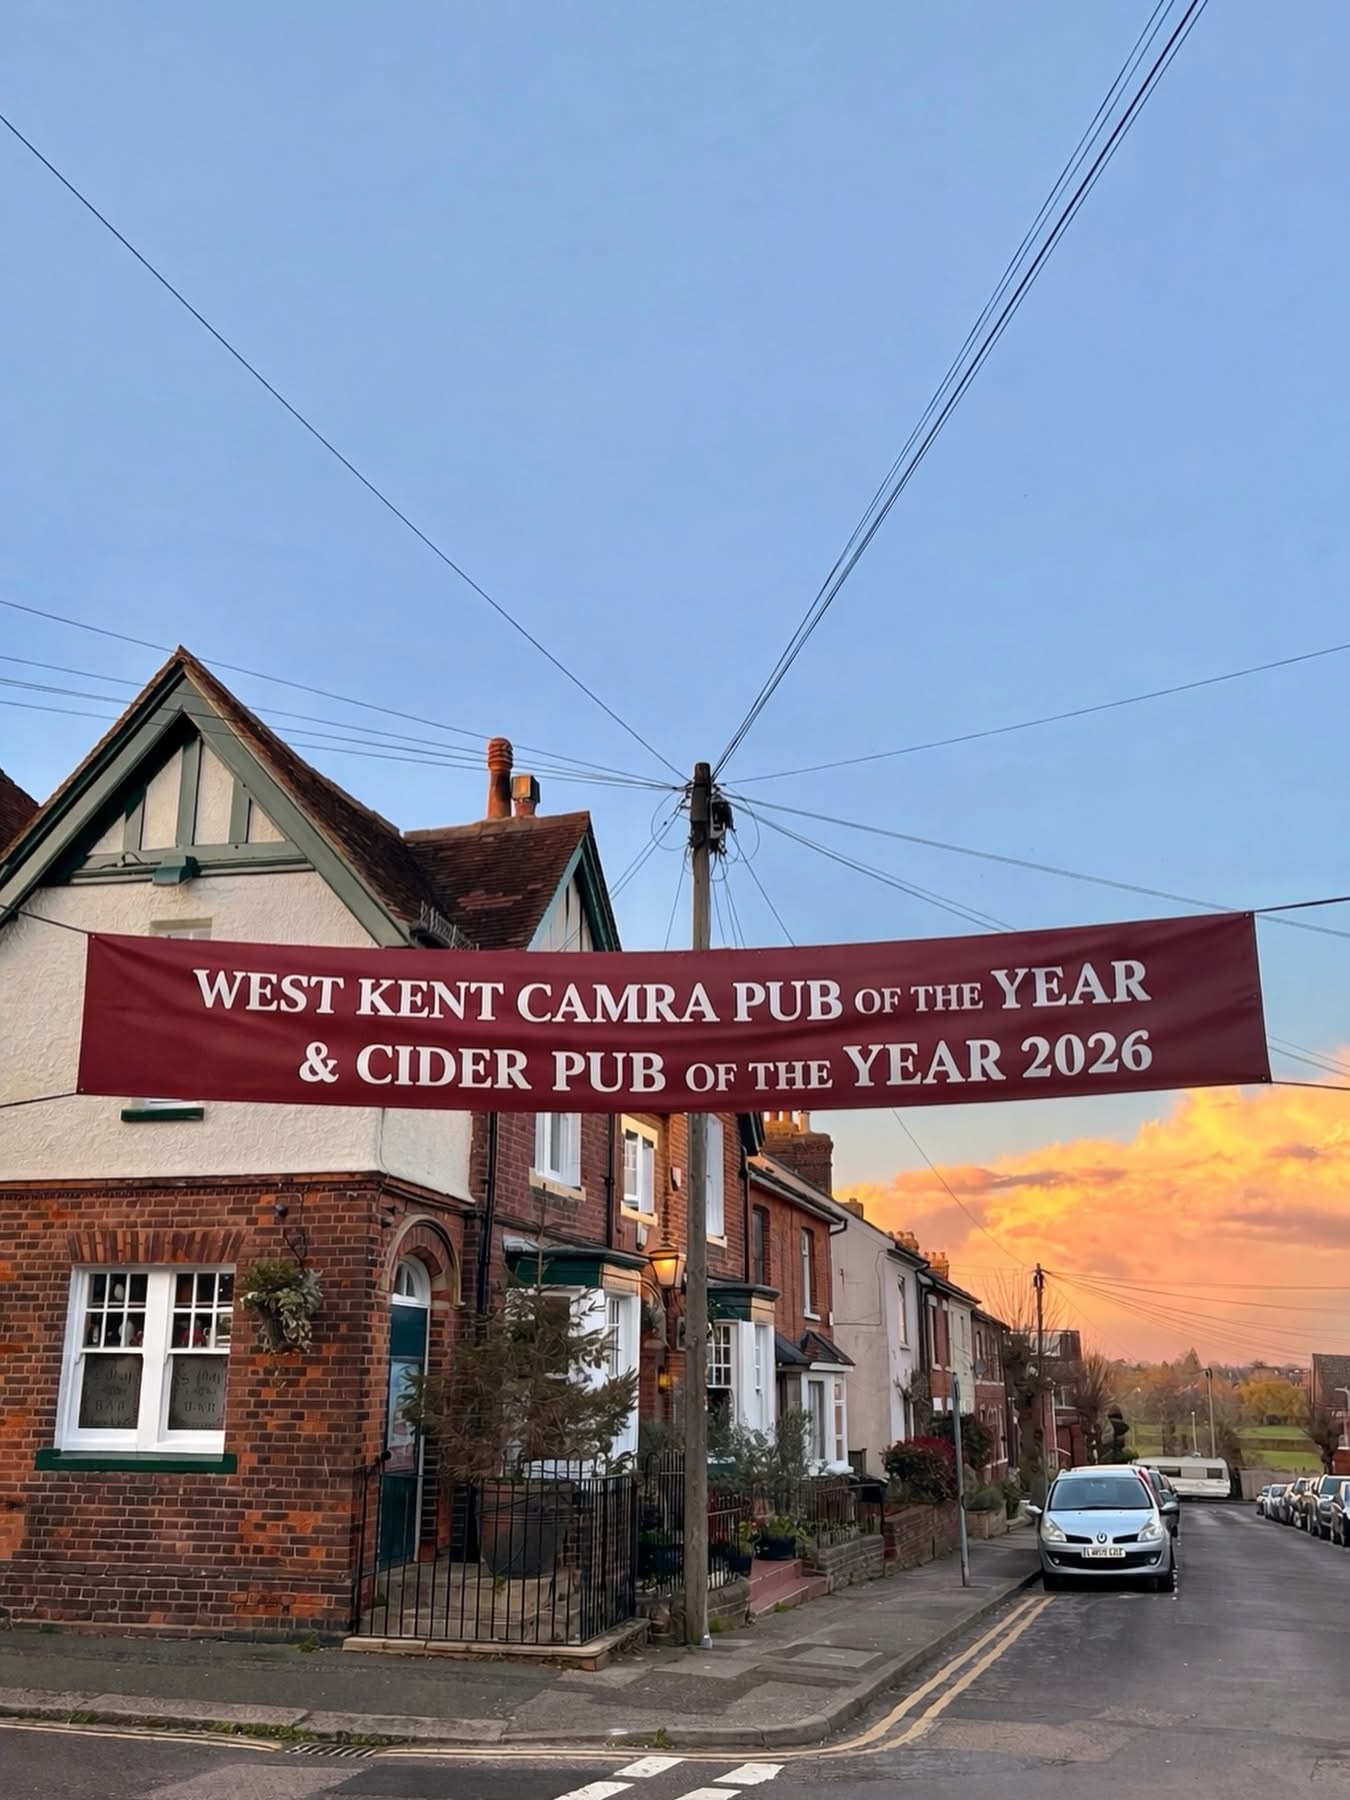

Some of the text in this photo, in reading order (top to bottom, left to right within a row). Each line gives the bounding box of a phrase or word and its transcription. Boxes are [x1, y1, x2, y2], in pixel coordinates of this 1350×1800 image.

[193, 960, 1152, 1023] WEST KENT CAMRA PUB OF THE YEAR
[299, 1029, 1153, 1093] & CIDER PUB OF THE YEAR 2026
